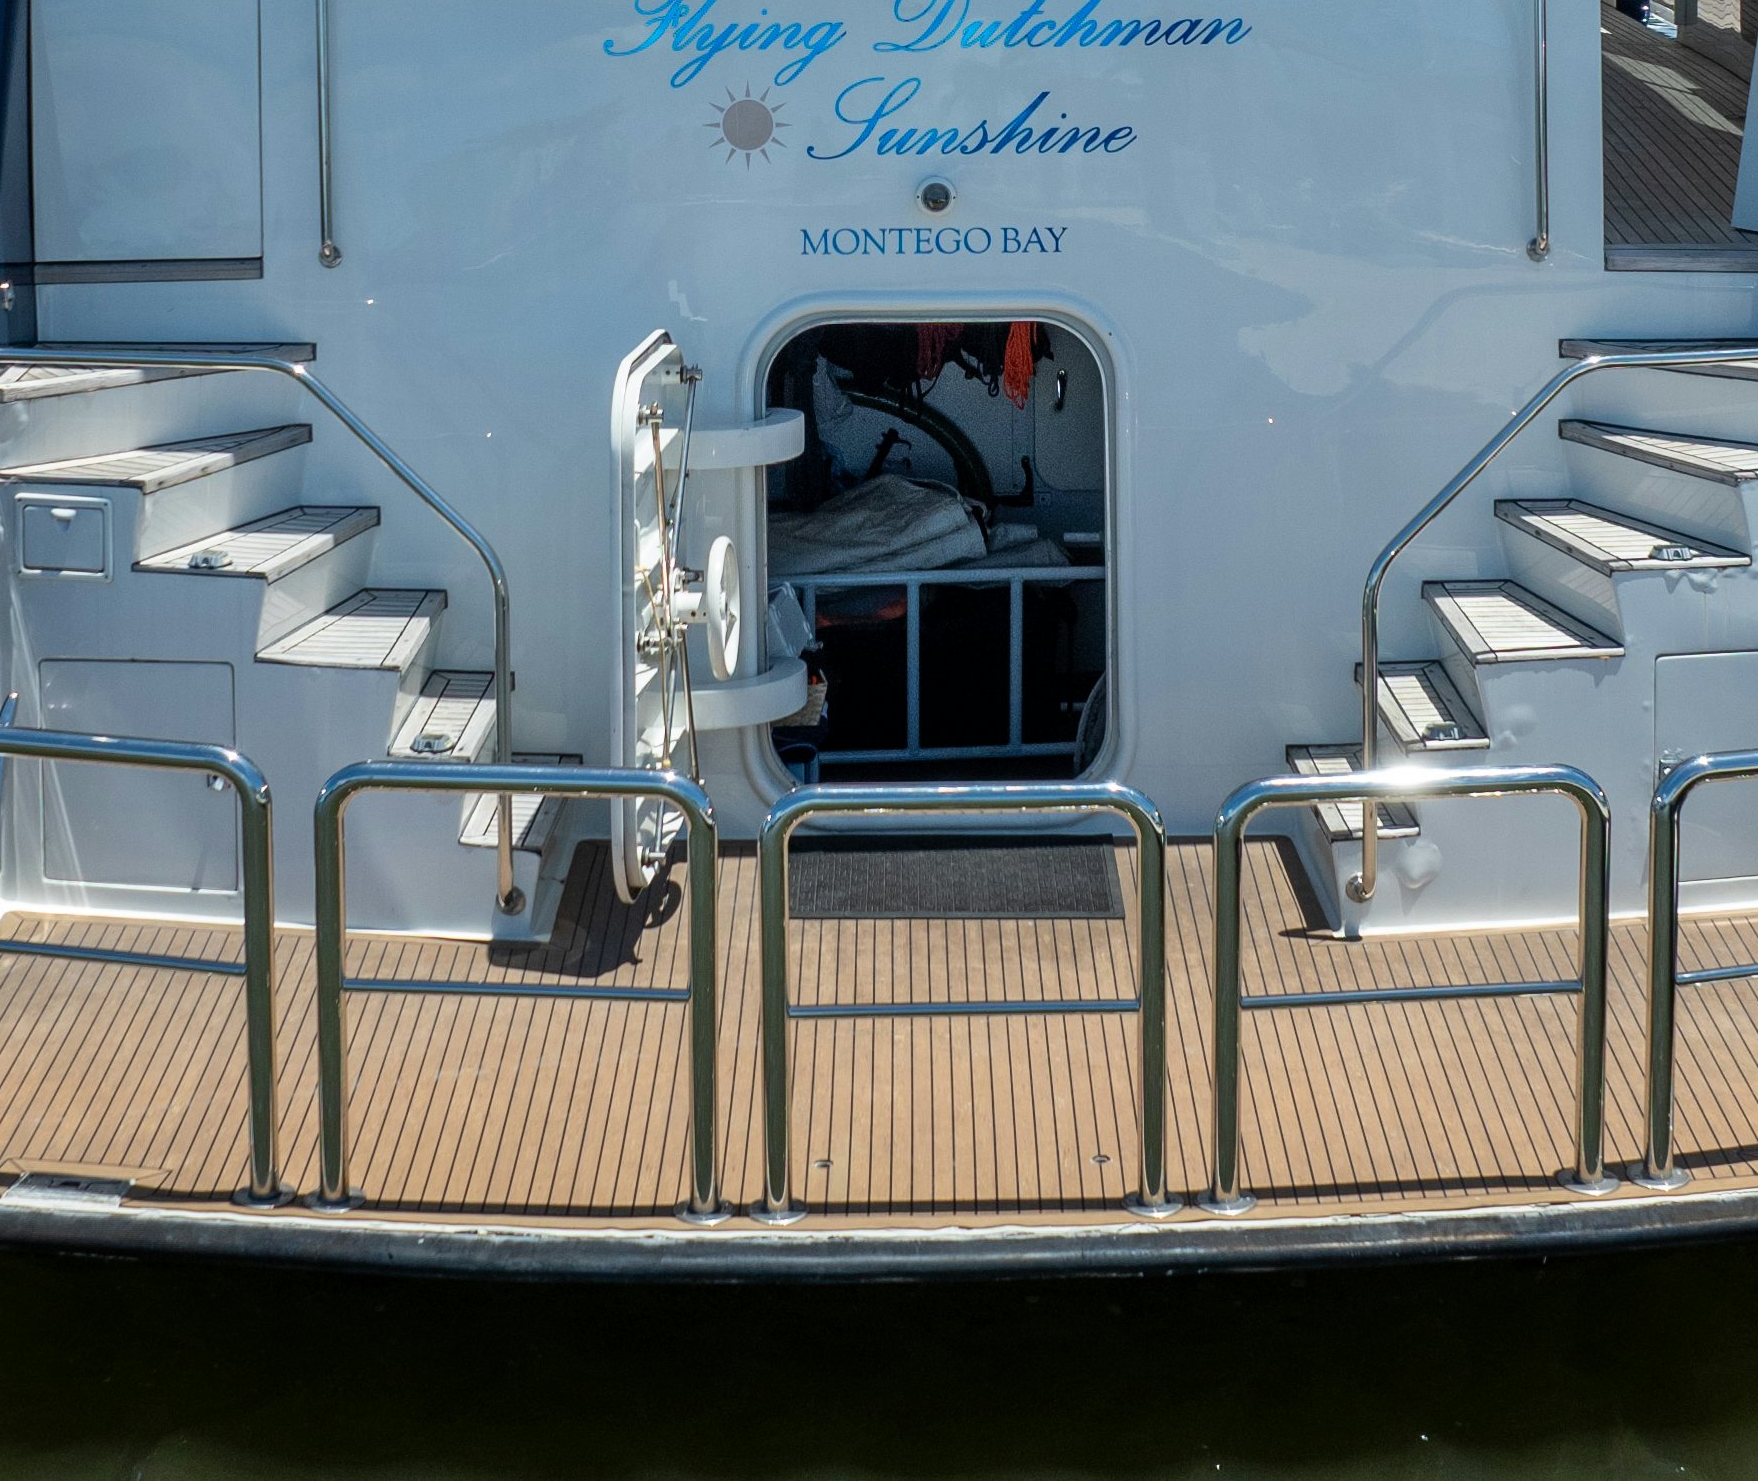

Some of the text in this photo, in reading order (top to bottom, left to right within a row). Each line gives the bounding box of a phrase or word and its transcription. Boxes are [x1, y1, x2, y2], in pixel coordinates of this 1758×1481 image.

[806, 76, 1137, 161] Sunshine
[800, 225, 1069, 257] MONTEGO BAY
